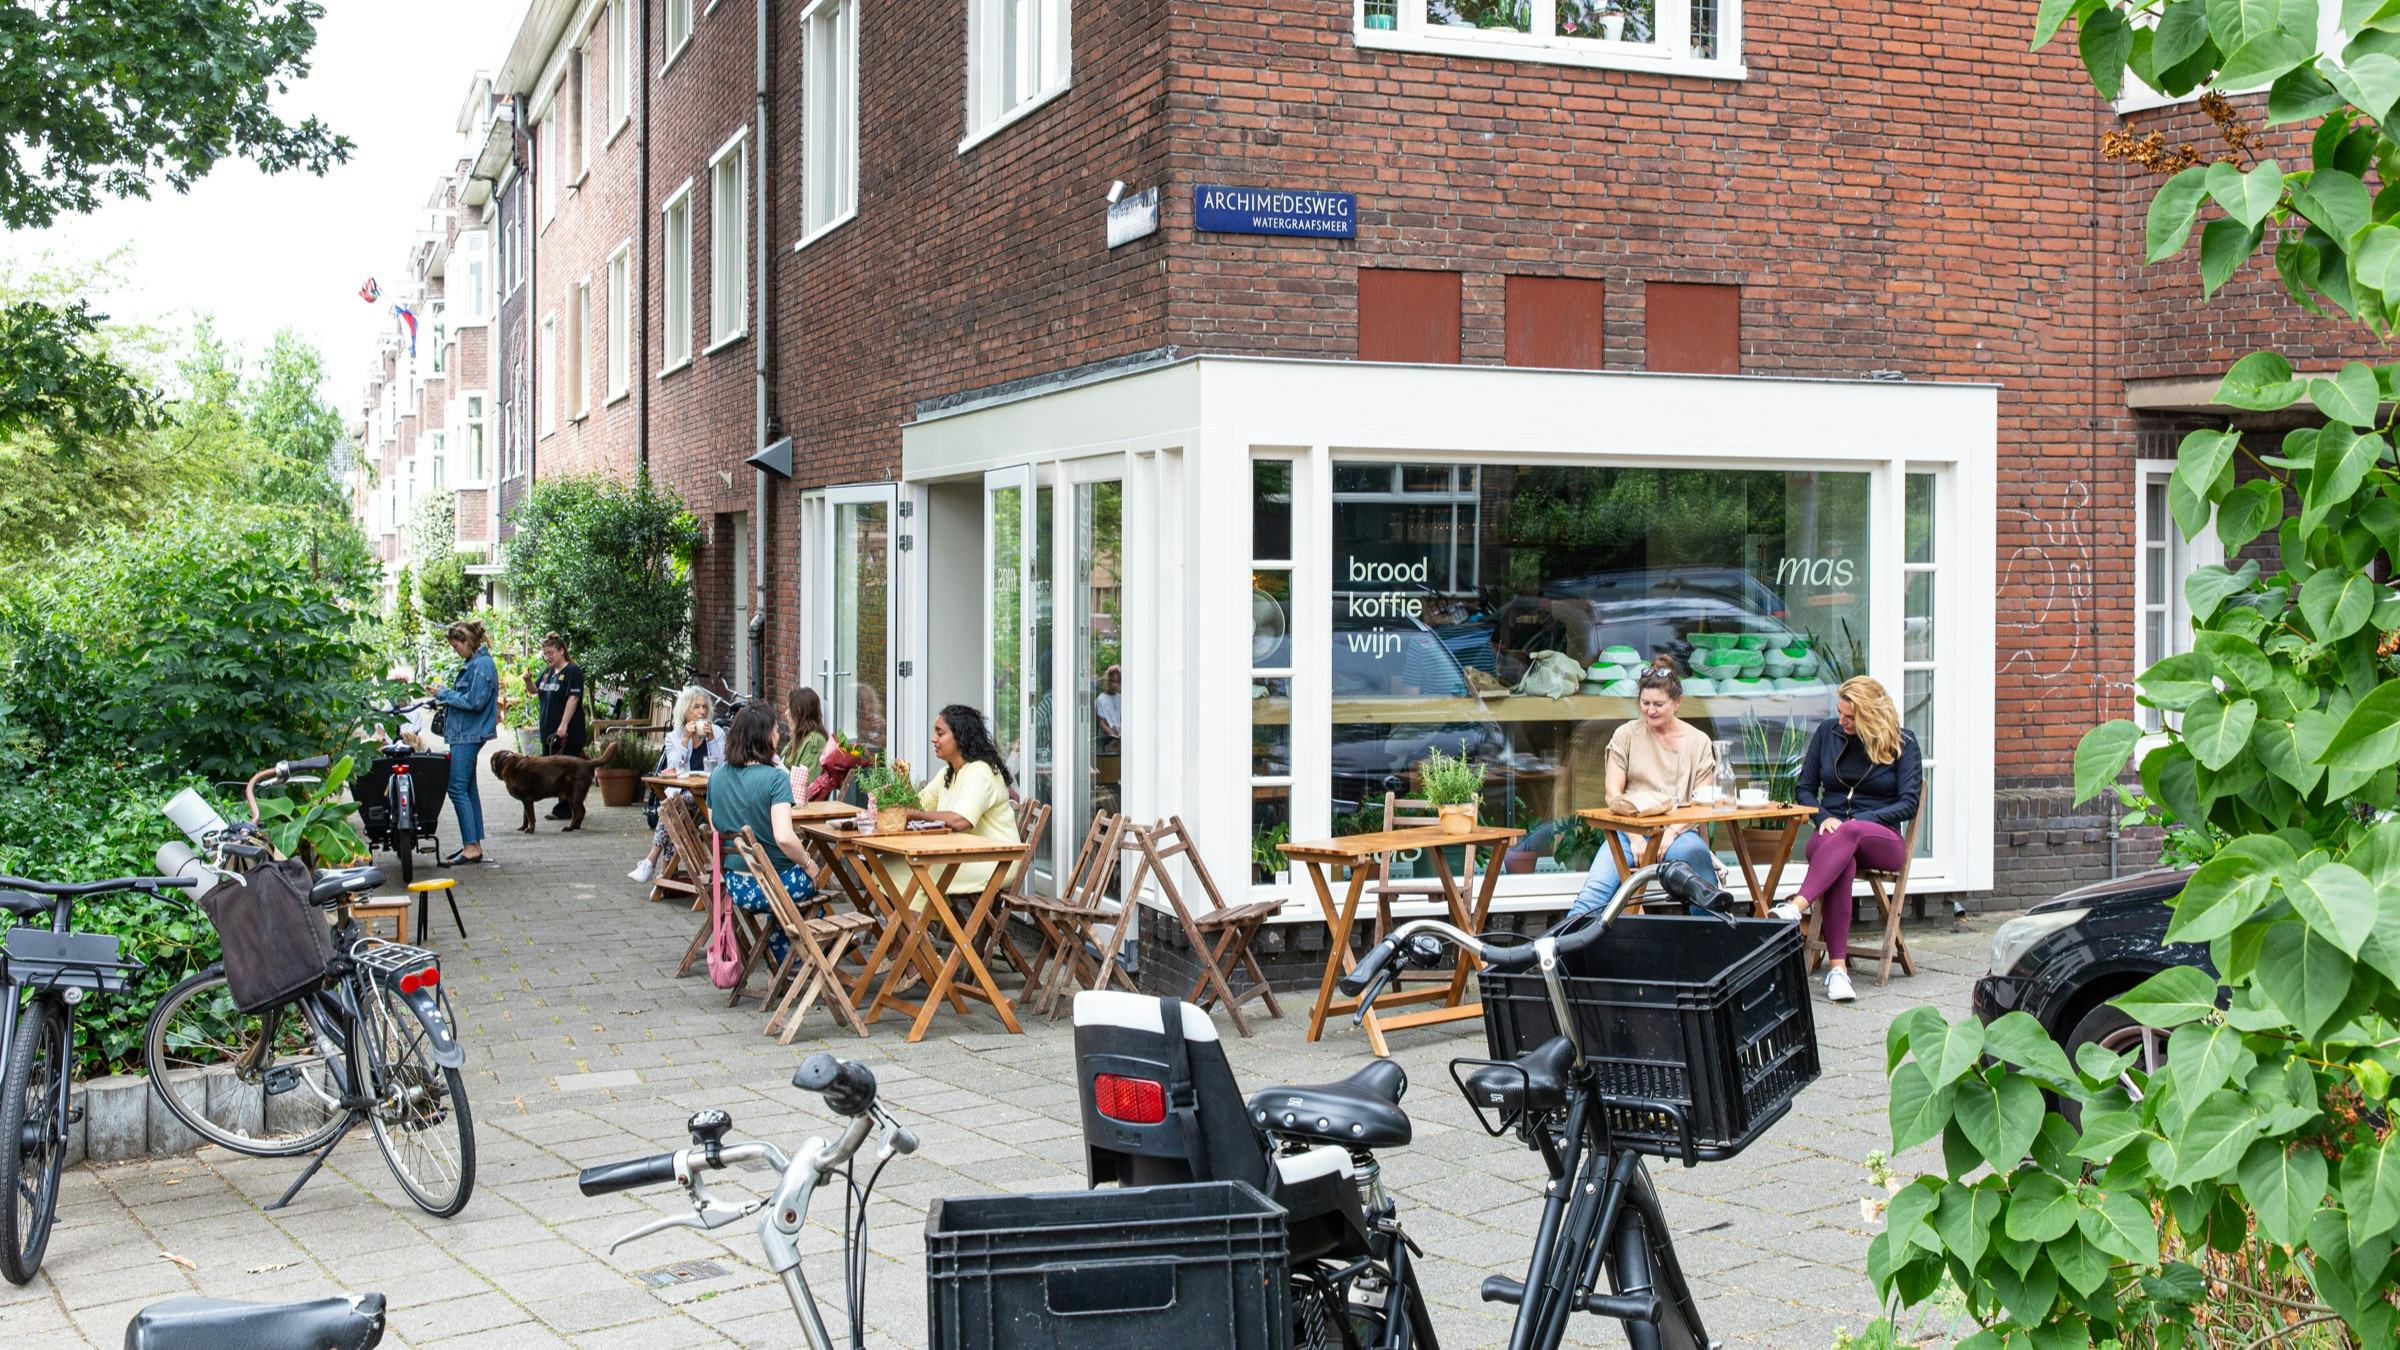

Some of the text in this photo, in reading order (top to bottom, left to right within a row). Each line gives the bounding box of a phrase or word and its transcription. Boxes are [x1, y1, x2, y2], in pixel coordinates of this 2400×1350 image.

[1252, 216, 1348, 233] WATERGRAAFSMEER
[1349, 555, 1428, 582] brood
[1776, 557, 1854, 586] mas
[1349, 591, 1423, 617] koffie
[1347, 626, 1402, 659] wijn
